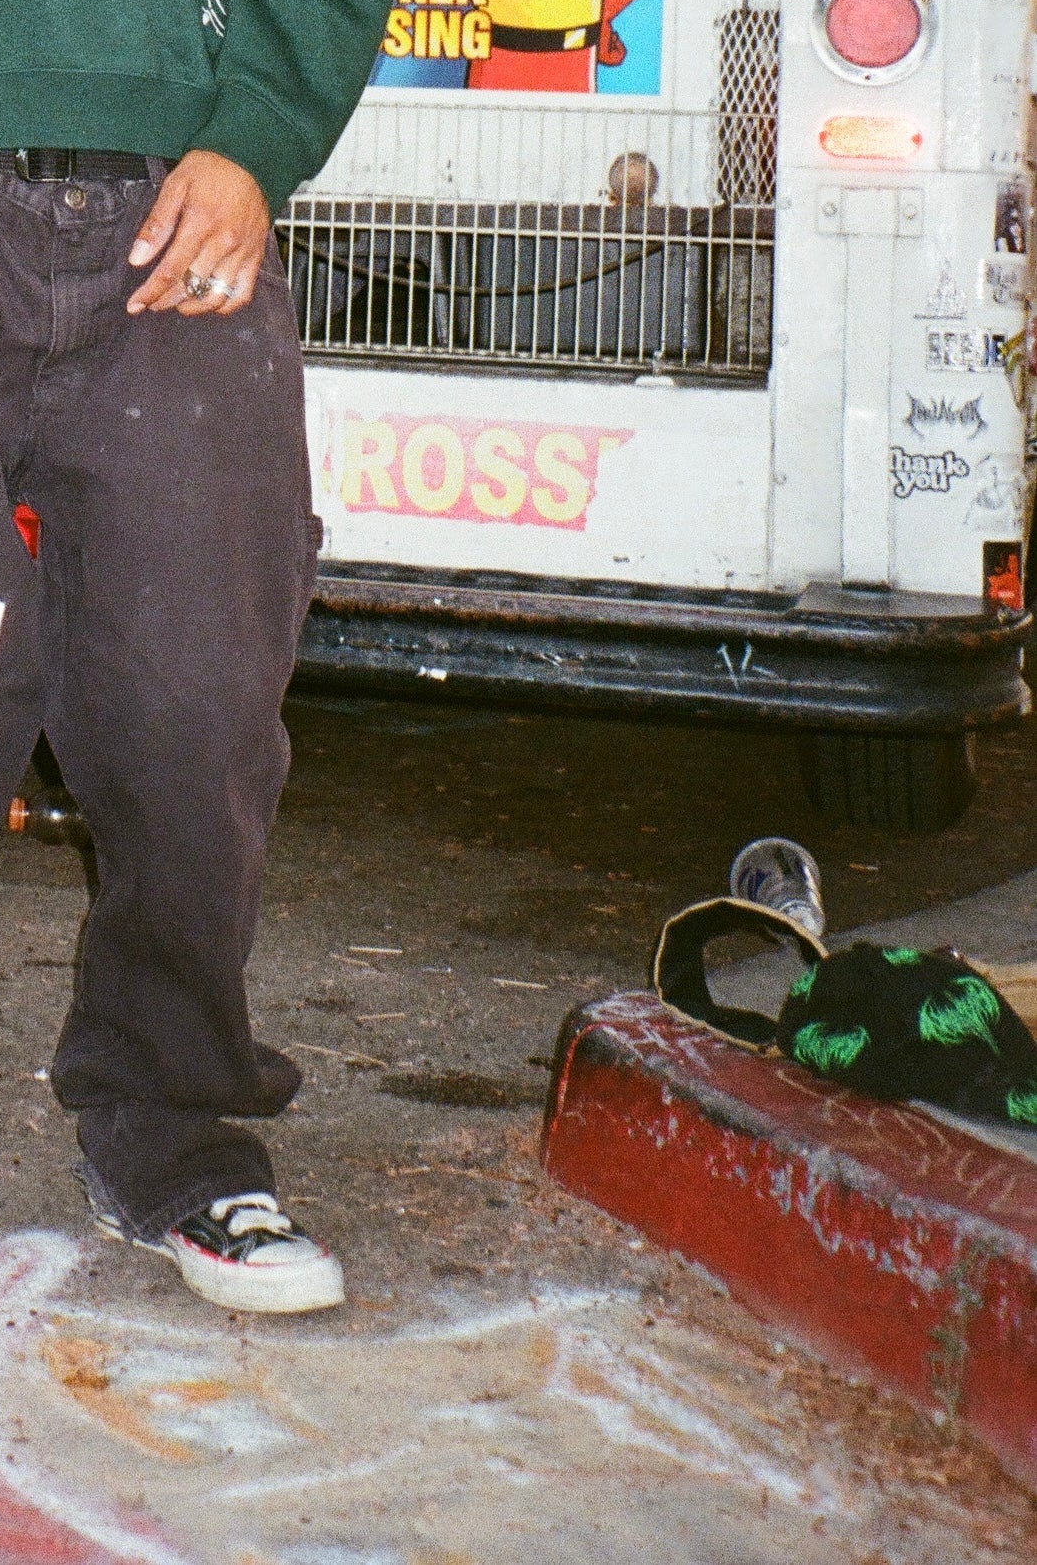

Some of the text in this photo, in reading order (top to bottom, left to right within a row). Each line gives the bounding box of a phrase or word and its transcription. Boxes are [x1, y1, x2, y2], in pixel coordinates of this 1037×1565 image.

[380, 8, 493, 60] SING
[321, 419, 590, 523] ROSS
[890, 447, 970, 478] hank
[893, 470, 950, 499] you
